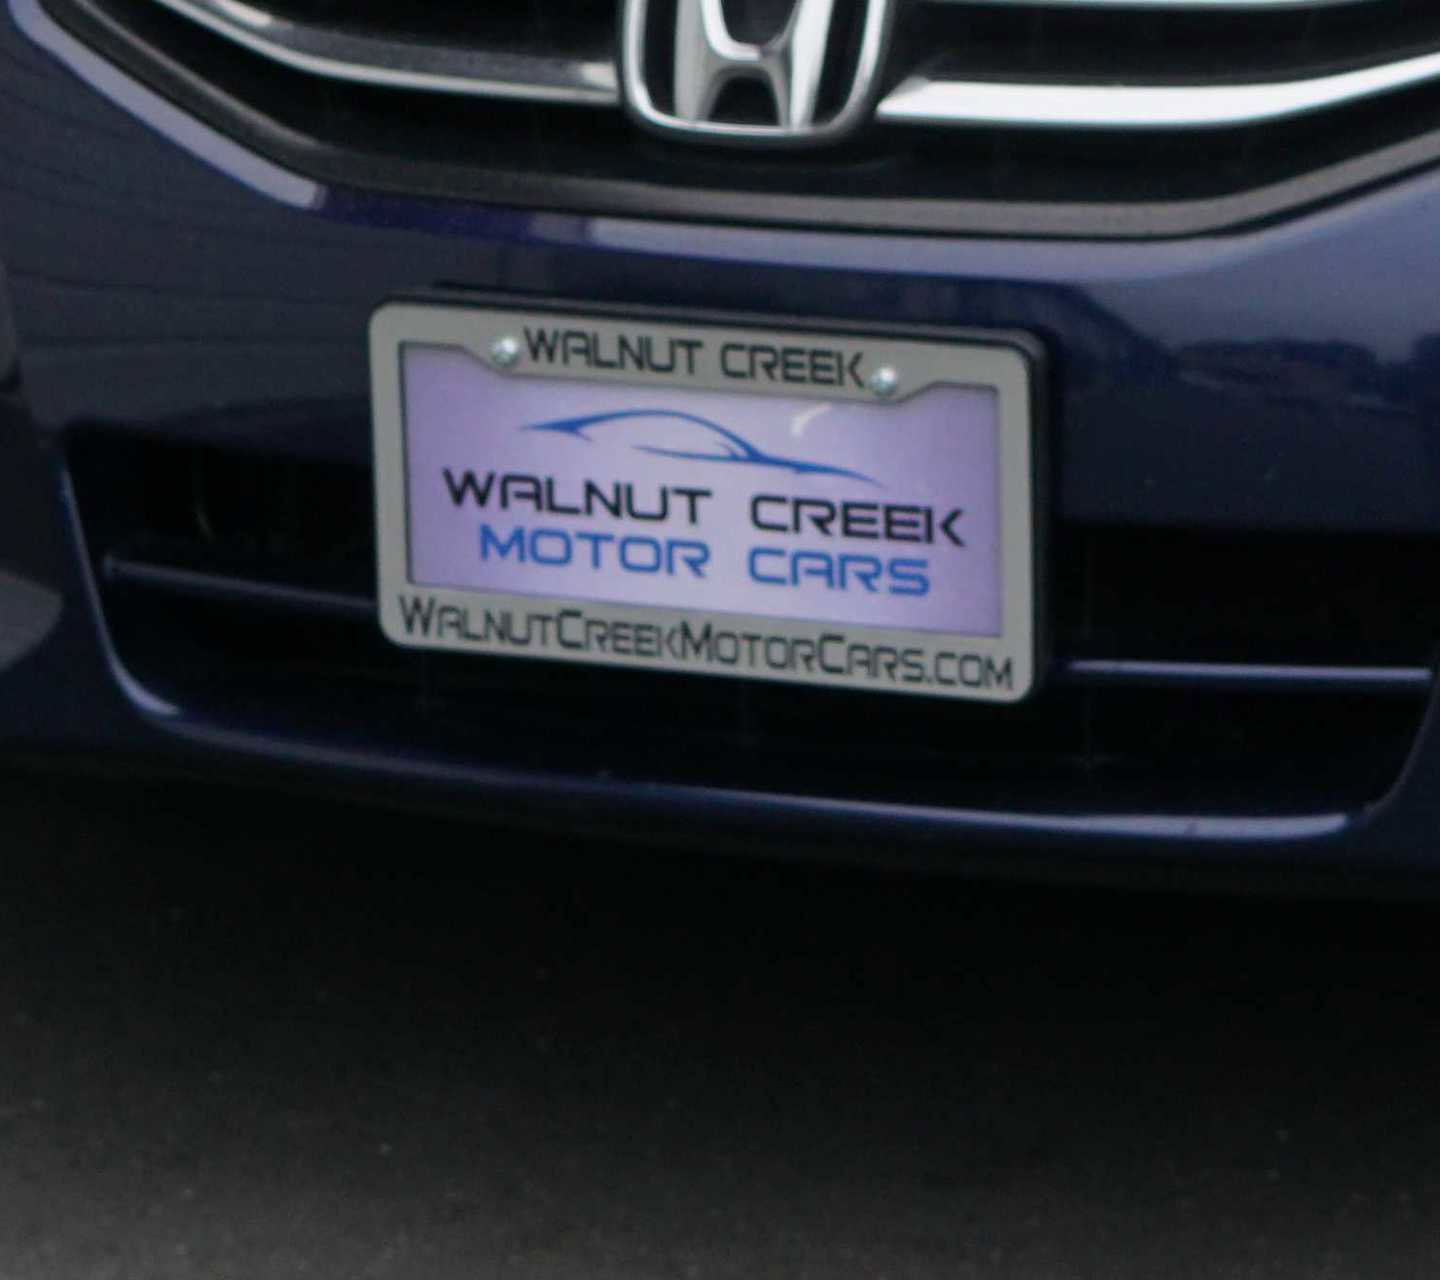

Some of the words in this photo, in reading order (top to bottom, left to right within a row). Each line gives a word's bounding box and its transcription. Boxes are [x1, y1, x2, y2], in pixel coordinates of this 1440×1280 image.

[523, 327, 704, 377] WALNUT
[720, 341, 865, 388] CREEK
[442, 467, 712, 524] WALNUT
[750, 493, 966, 547] CREEK
[479, 522, 710, 579] MOTOR
[748, 546, 930, 597] CARS
